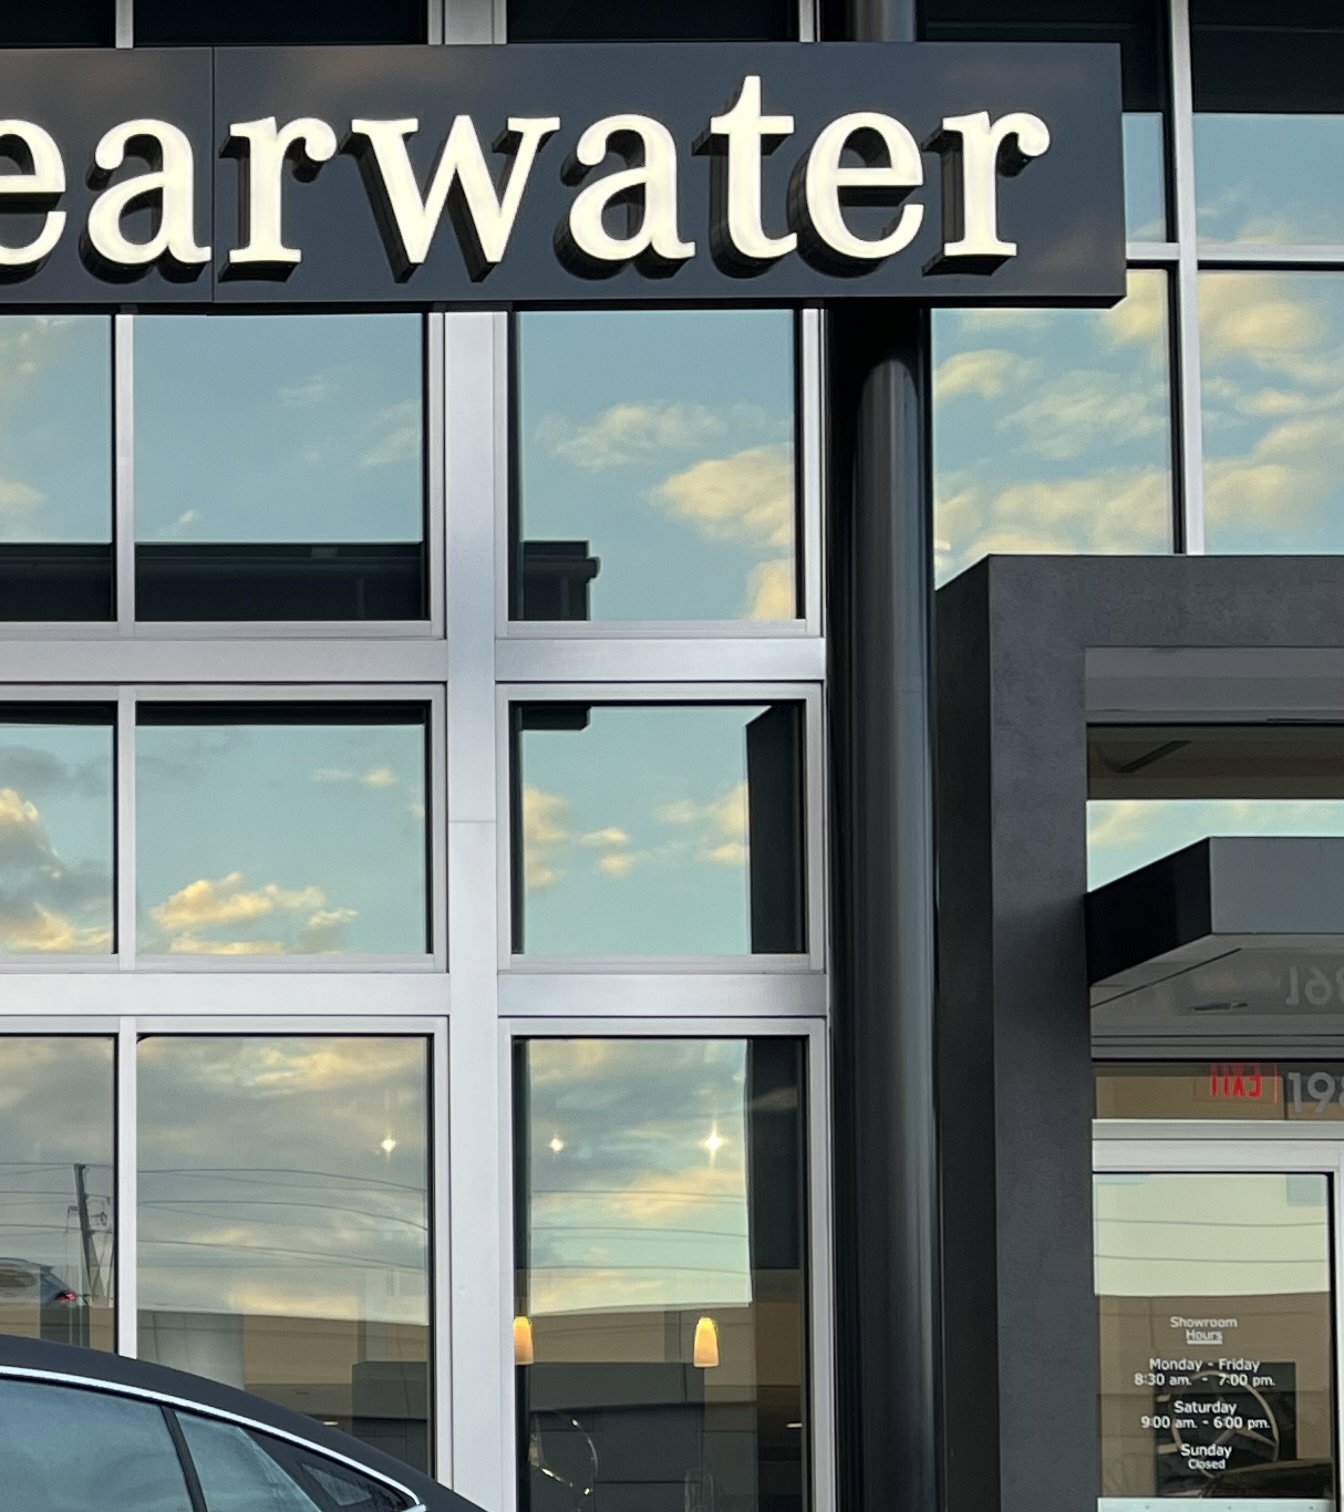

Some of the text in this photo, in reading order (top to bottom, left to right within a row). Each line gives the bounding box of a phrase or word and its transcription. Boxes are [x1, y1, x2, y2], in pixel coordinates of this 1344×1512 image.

[1287, 1071, 1344, 1112] 19
[1170, 1316, 1238, 1328] Showroom
[1186, 1329, 1223, 1341] Hours
[1149, 1358, 1203, 1373] Monday
[1218, 1358, 1261, 1373] Friday
[1134, 1373, 1166, 1386] 8:30
[1169, 1376, 1192, 1386] am.
[1218, 1373, 1248, 1386] 7:00
[1252, 1376, 1276, 1388] pm.
[1173, 1401, 1238, 1415] Saturday
[1140, 1416, 1171, 1429] 9:00
[1175, 1419, 1197, 1429] am.
[1213, 1416, 1243, 1429] 6:00
[1247, 1419, 1271, 1431] pm.
[1180, 1443, 1233, 1458] Sunday
[1188, 1458, 1226, 1470] Closed
